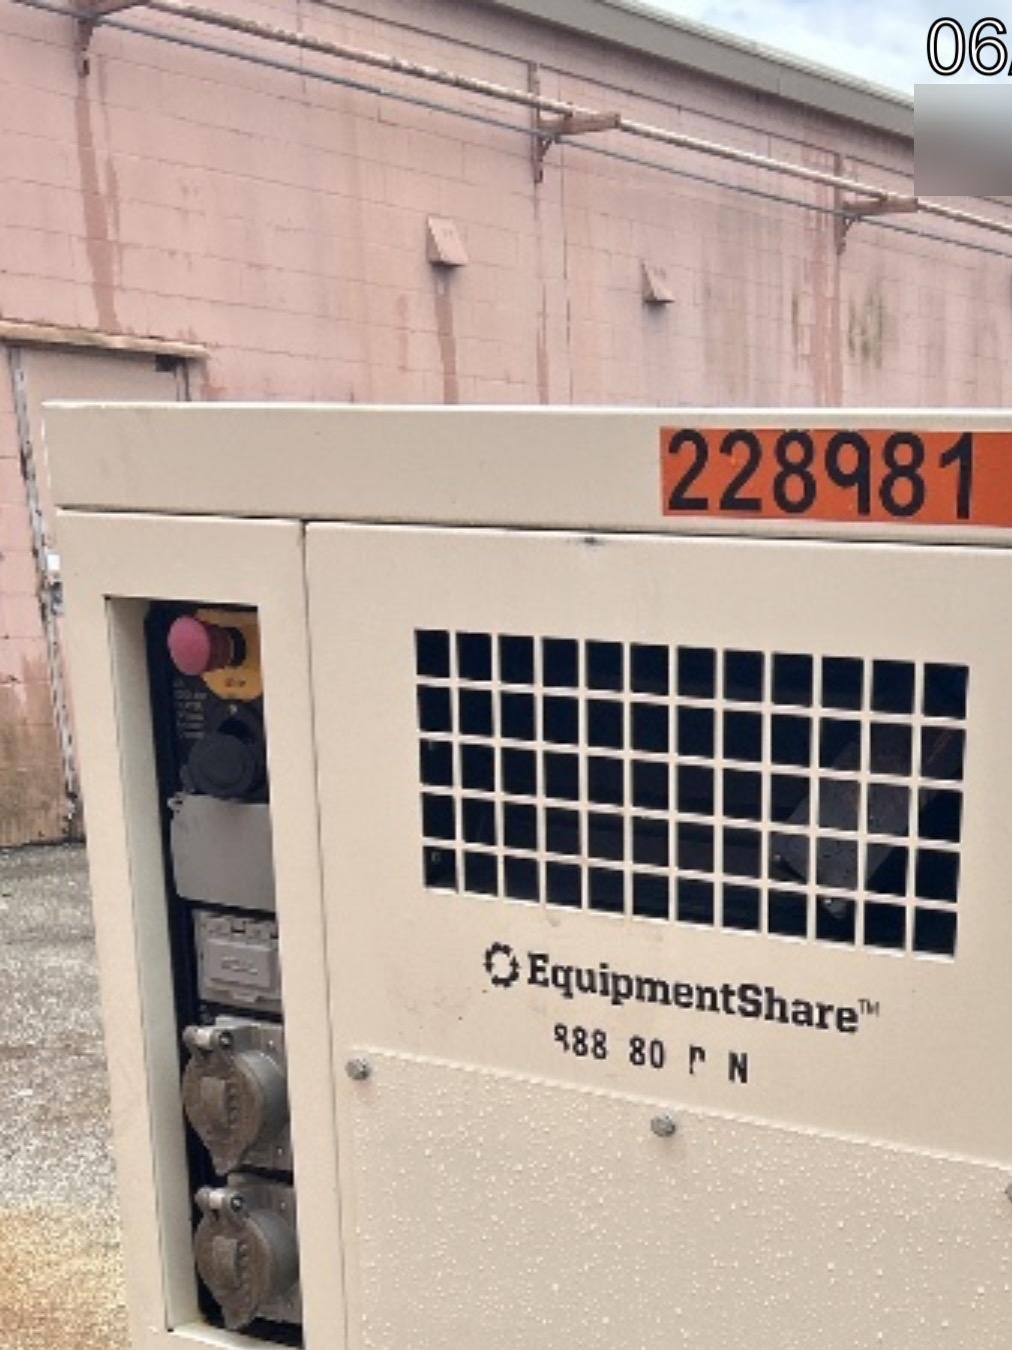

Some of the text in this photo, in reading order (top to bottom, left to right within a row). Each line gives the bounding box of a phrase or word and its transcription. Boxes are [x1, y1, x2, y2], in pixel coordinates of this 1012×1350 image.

[667, 428, 975, 521] 228981
[629, 1034, 665, 1069] 80
[728, 1051, 749, 1084] N
